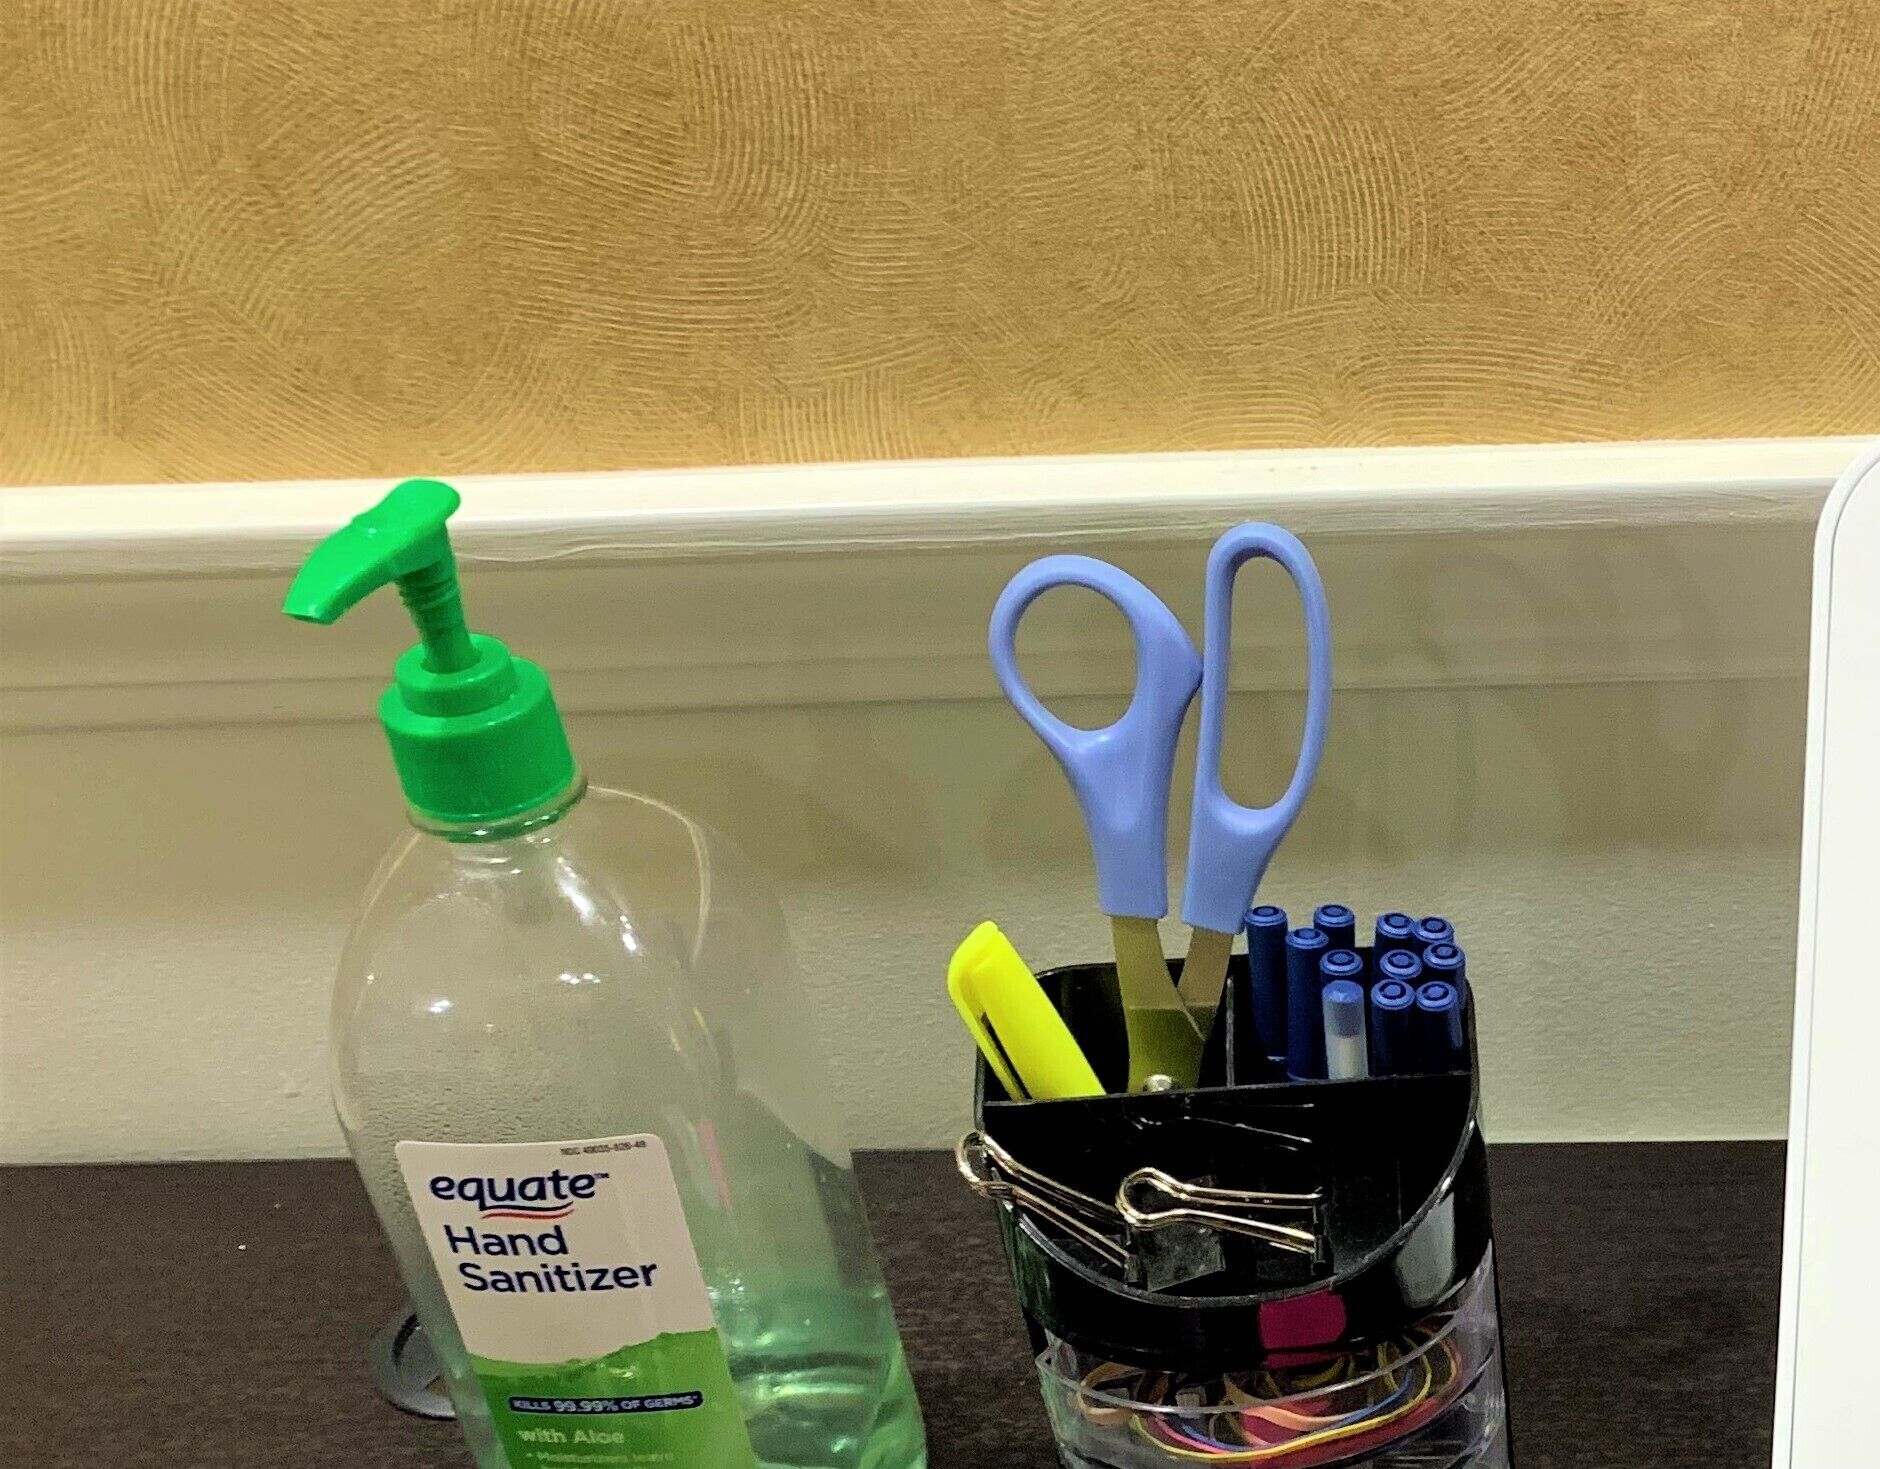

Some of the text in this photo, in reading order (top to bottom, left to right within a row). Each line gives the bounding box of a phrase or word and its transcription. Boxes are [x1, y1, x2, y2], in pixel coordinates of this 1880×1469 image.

[443, 1225, 569, 1256] Hand
[459, 1262, 658, 1293] Sanitizer
[512, 1399, 551, 1411] KILLS
[553, 1400, 619, 1412] 99.99%
[620, 1399, 641, 1410] OF
[516, 1427, 625, 1444] with Aloe
